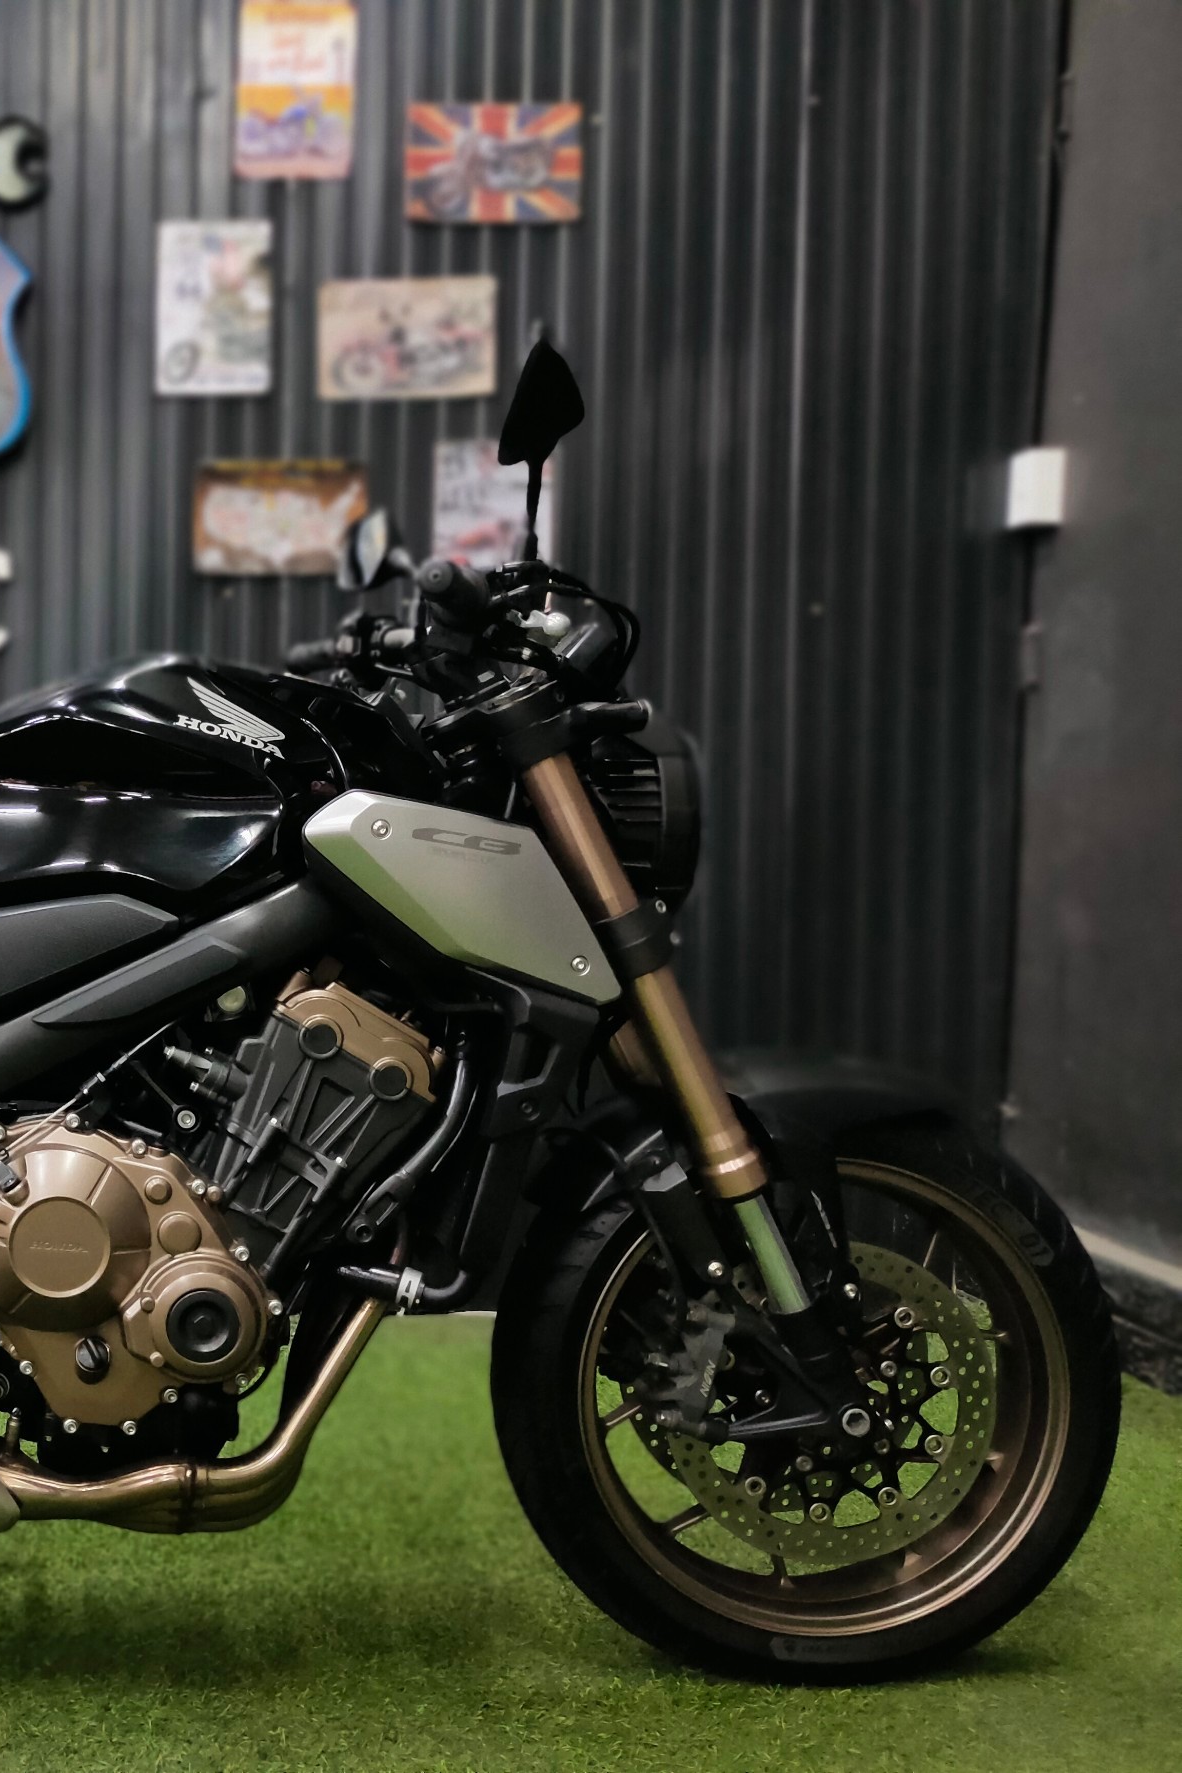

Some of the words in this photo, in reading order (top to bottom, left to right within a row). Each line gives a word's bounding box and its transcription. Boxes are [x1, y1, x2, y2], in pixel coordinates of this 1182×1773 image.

[173, 714, 285, 760] HONDA
[412, 827, 521, 855] CB
[29, 1241, 89, 1254] HONDA
